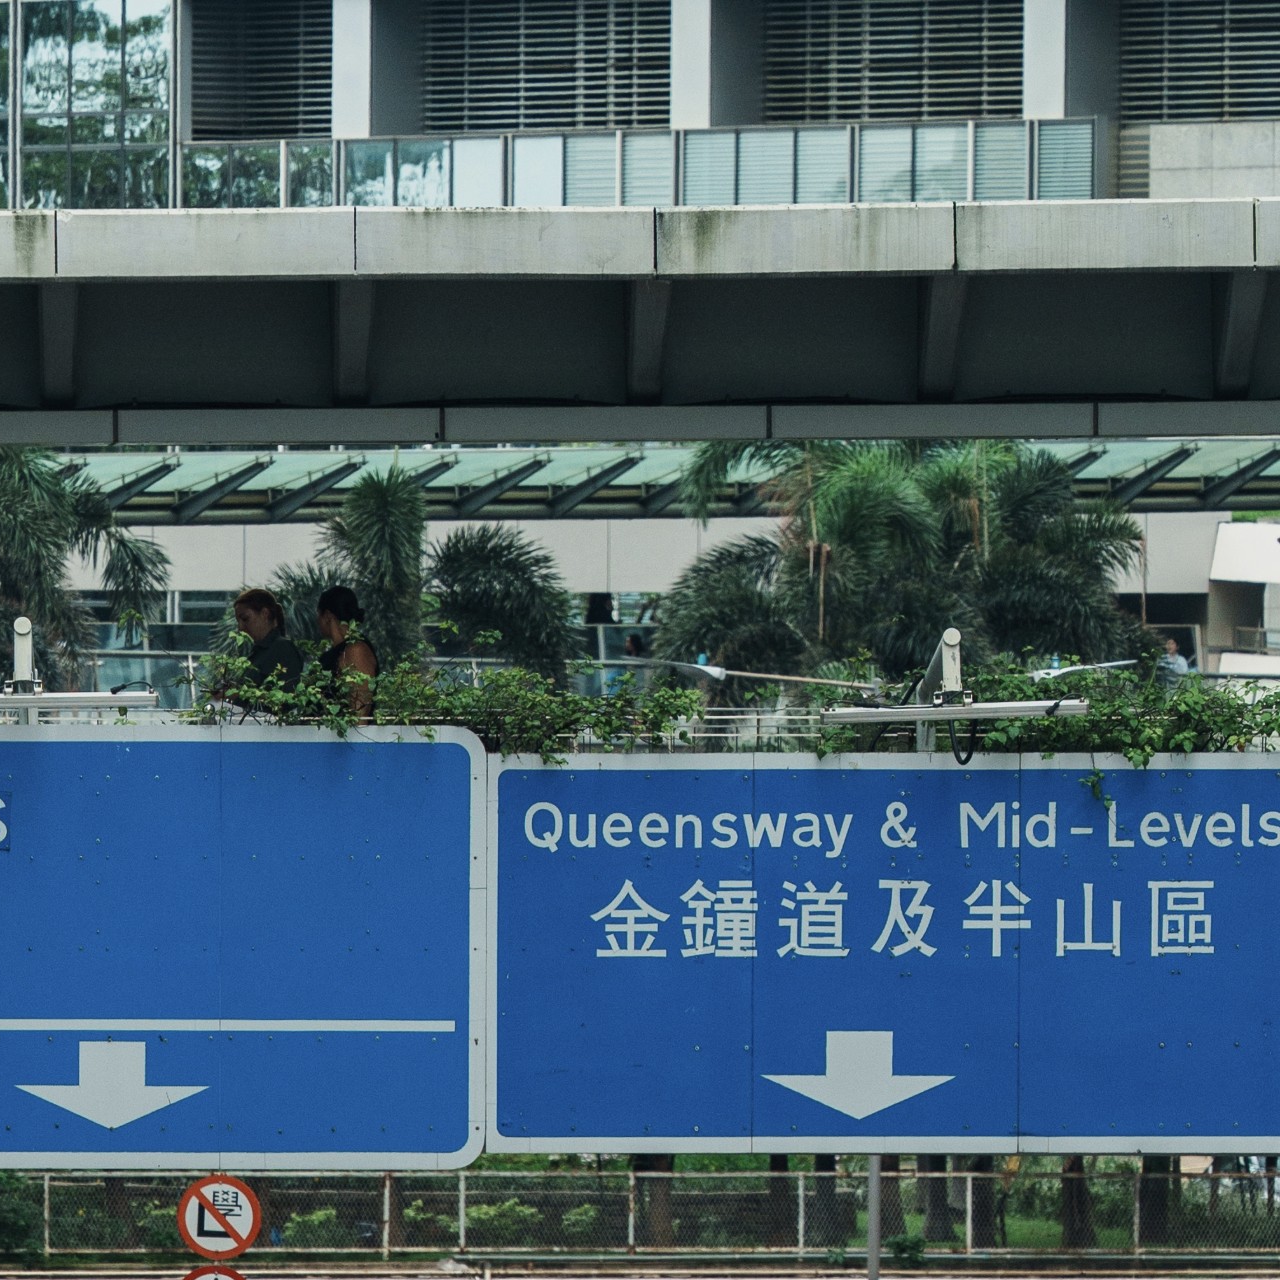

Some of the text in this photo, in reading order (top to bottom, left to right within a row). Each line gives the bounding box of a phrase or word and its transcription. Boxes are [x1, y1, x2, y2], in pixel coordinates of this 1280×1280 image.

[524, 802, 854, 858] Queensway
[880, 801, 917, 848] &
[591, 879, 1215, 957] 金鐘道及半山區
